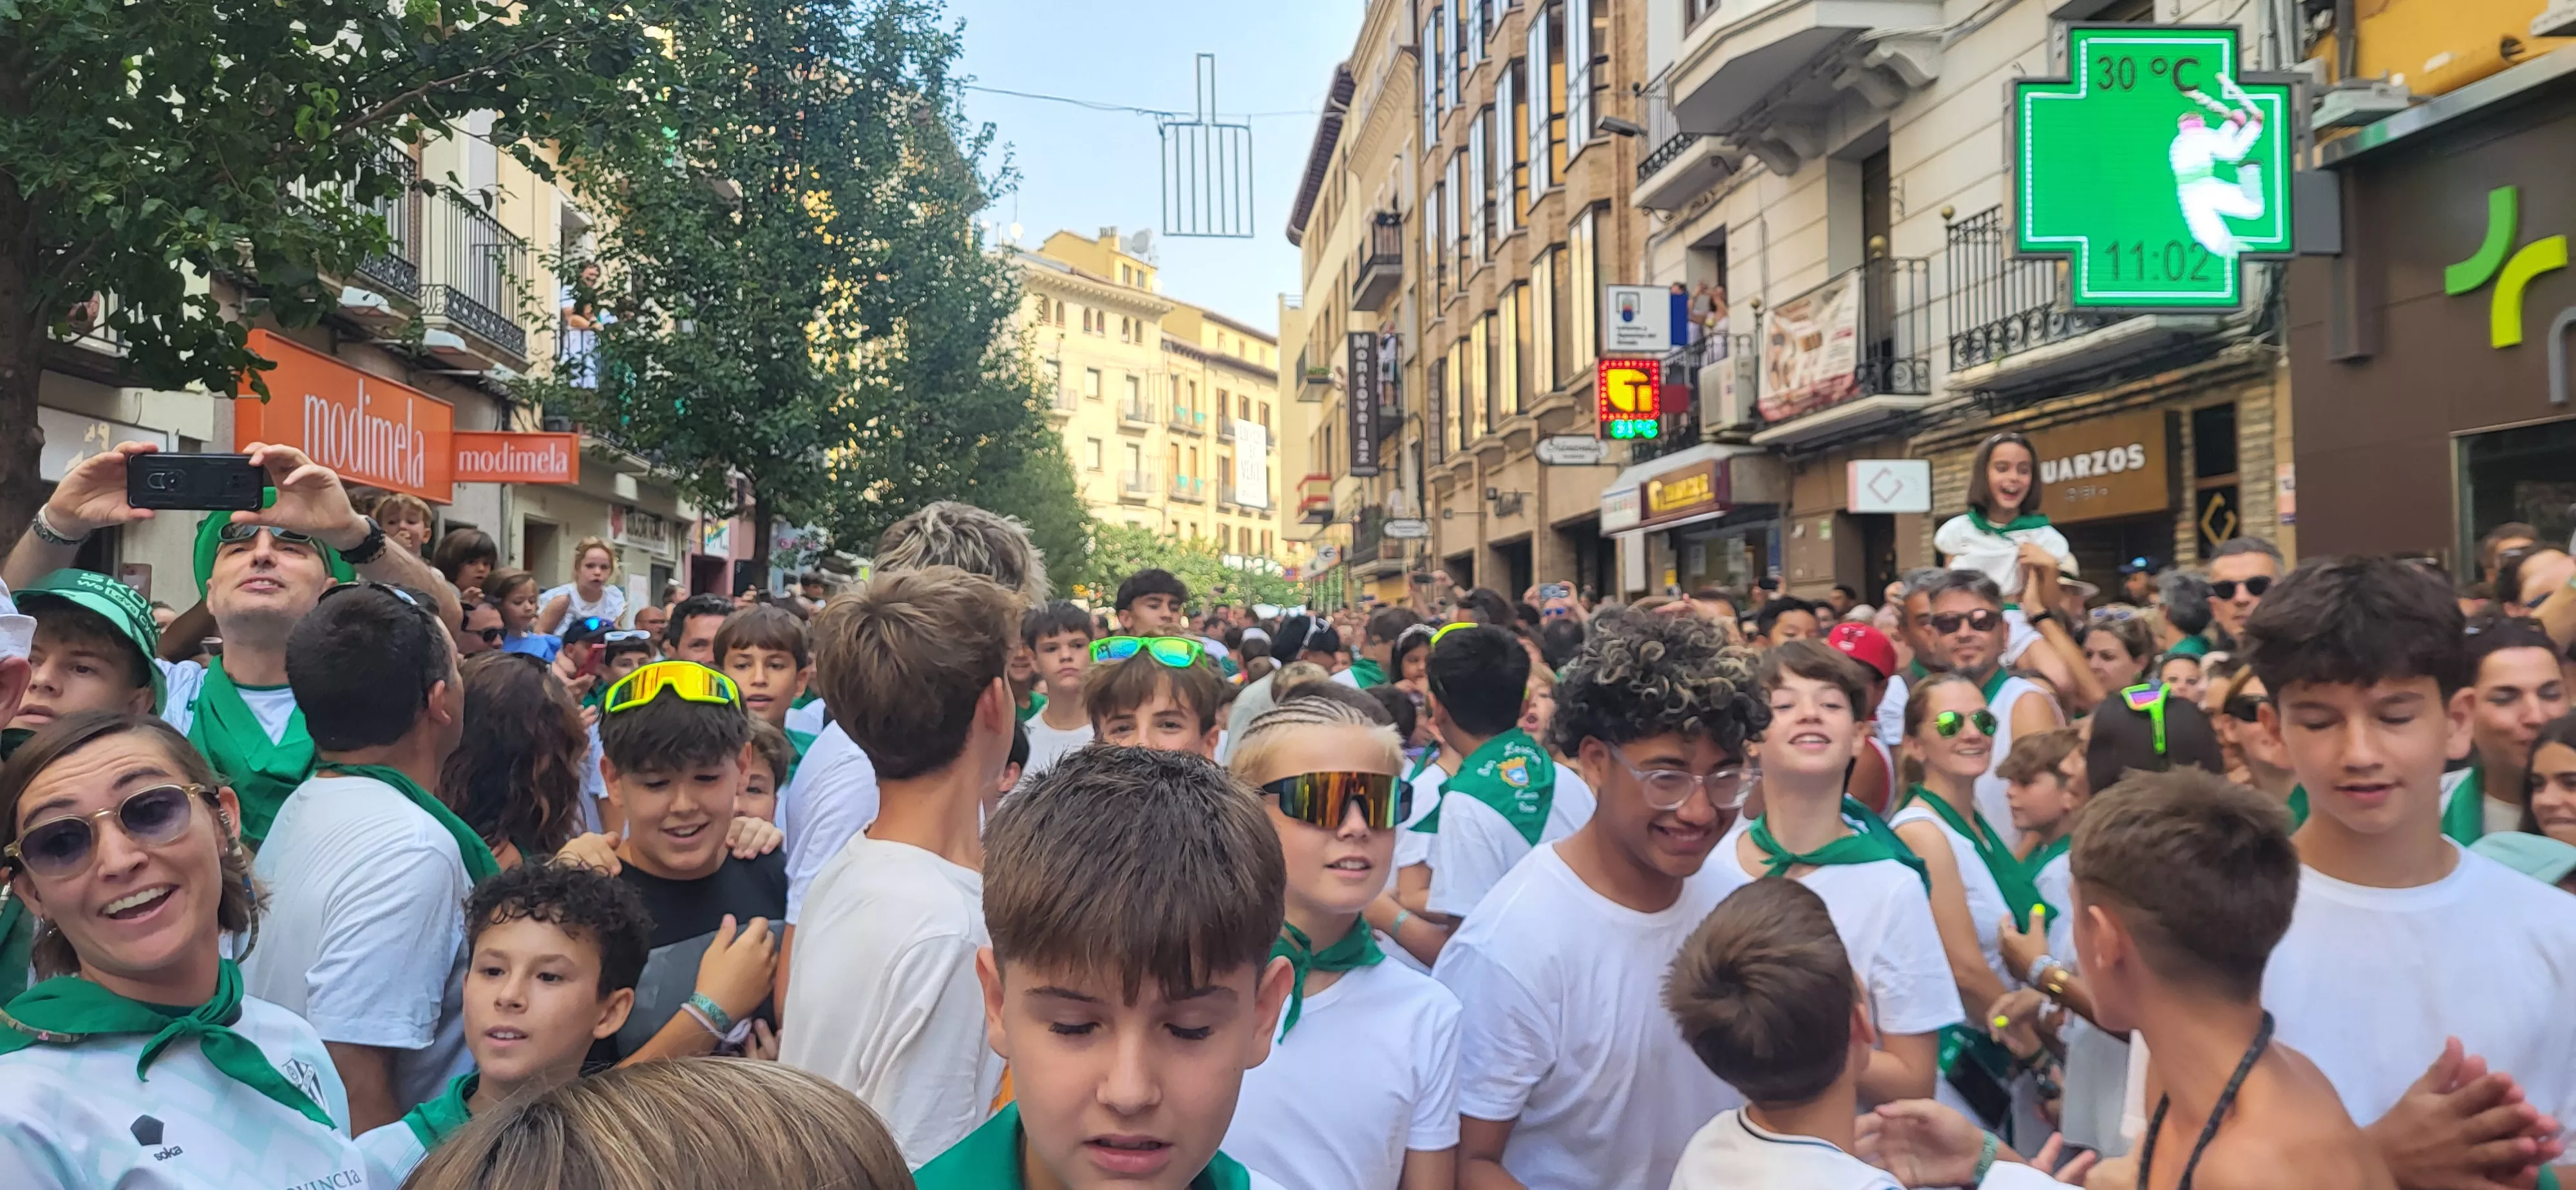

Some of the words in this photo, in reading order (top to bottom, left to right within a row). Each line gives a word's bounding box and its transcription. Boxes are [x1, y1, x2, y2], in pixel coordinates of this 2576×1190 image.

[2096, 56, 2136, 91] 30
[2150, 56, 2200, 92] °C
[2105, 240, 2209, 282] 11:02
[304, 377, 424, 488] modimela
[458, 441, 568, 474] modimela
[2040, 443, 2145, 485] UARZOS
[153, 1145, 184, 1162] soka
